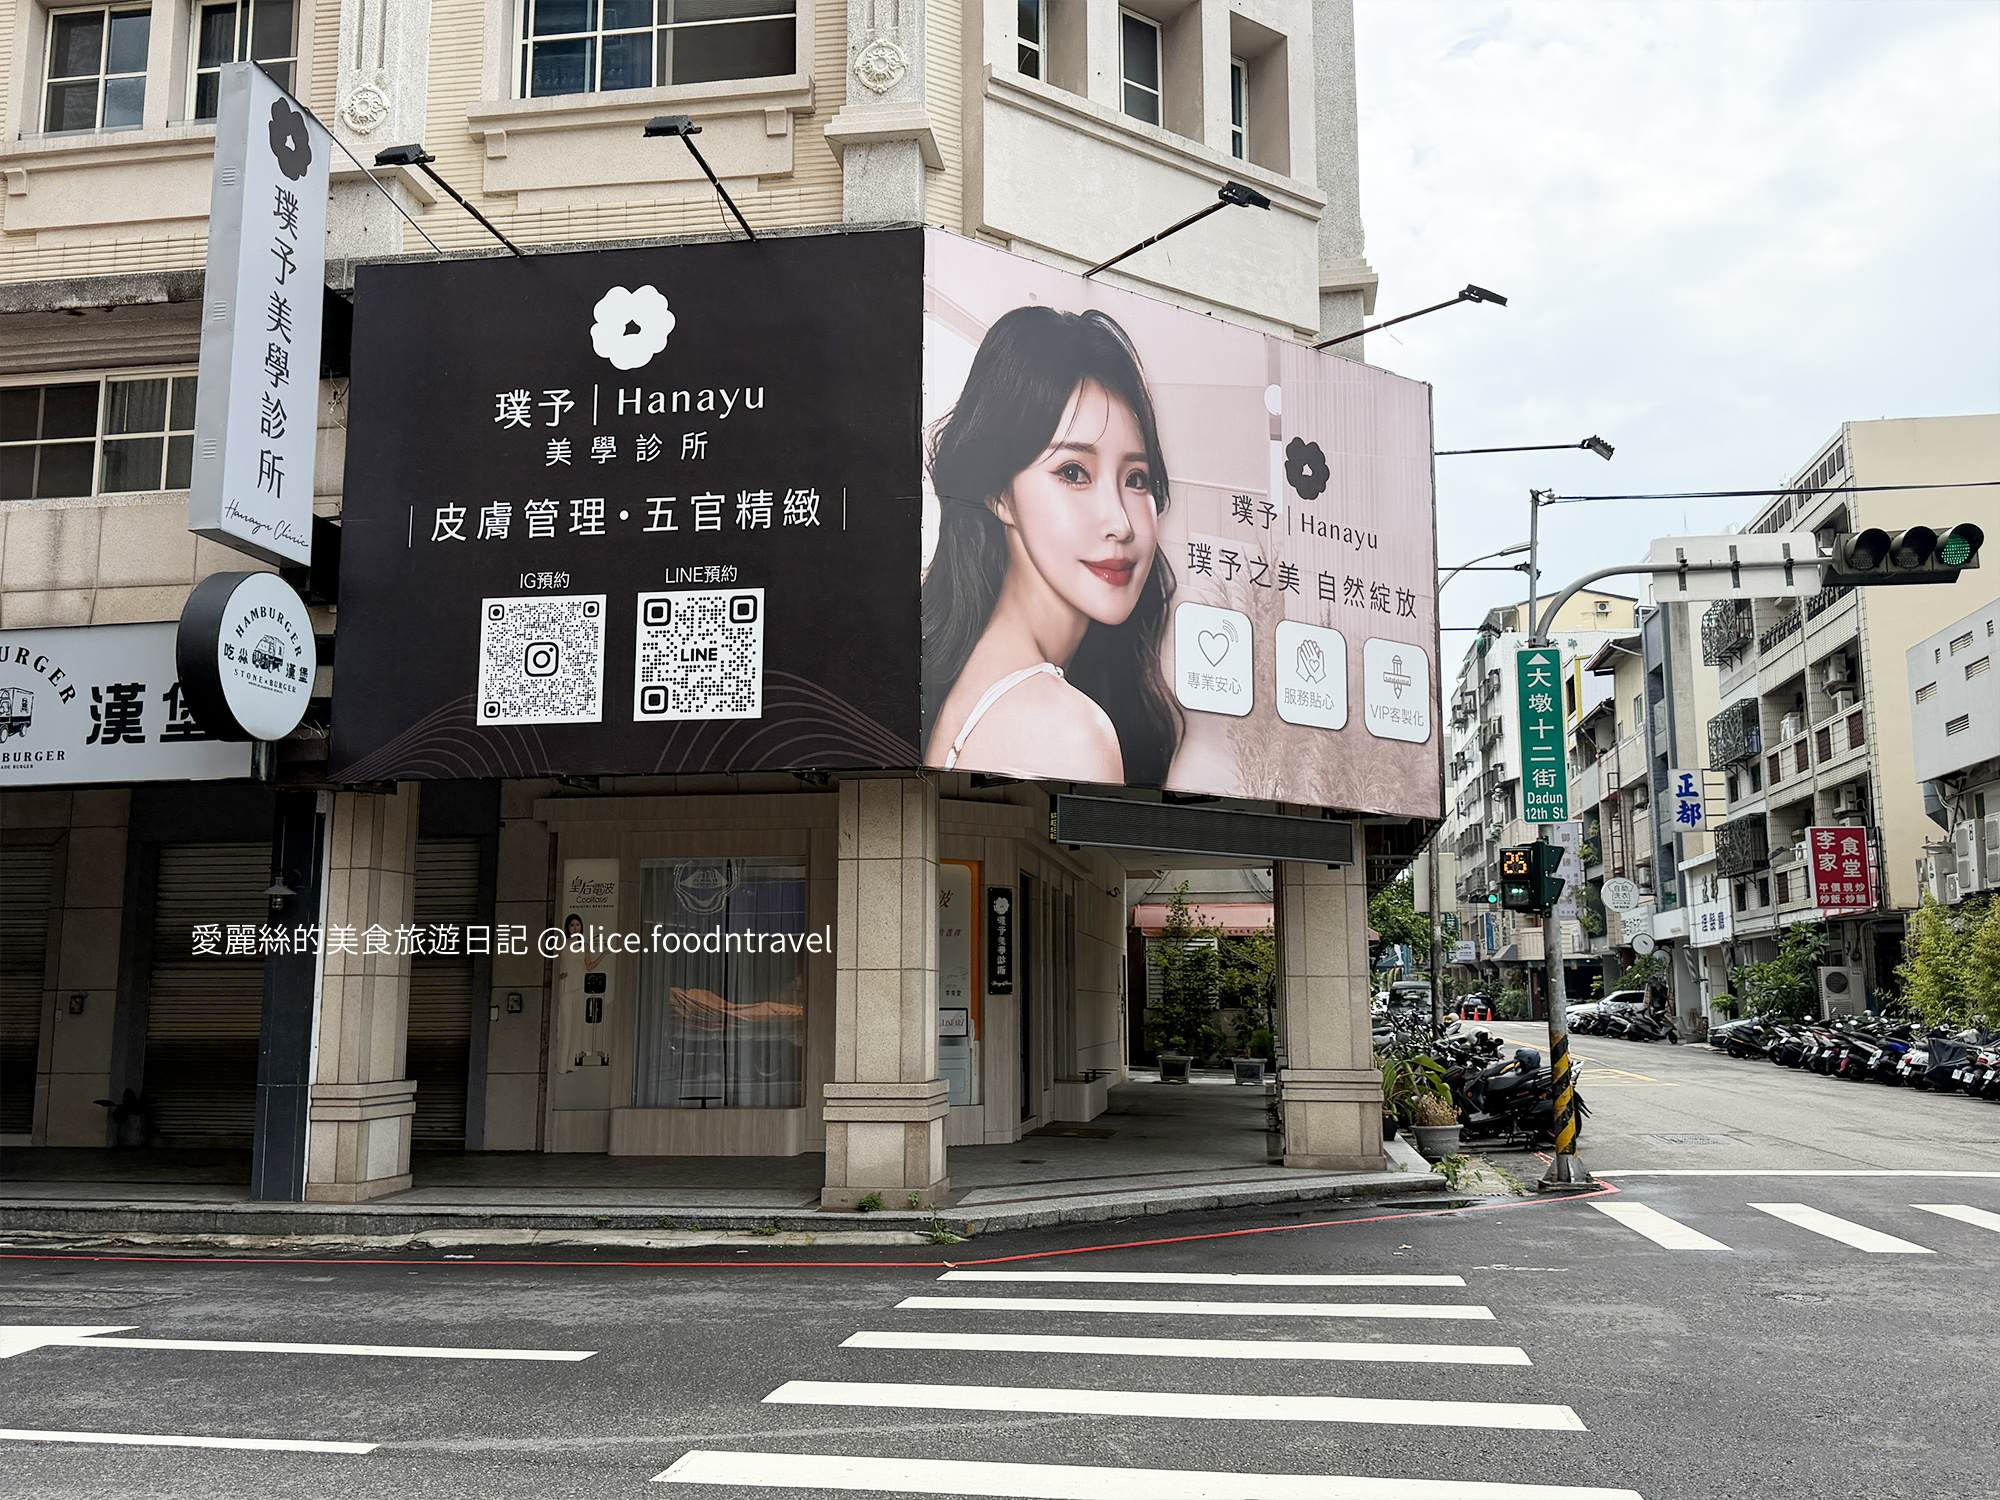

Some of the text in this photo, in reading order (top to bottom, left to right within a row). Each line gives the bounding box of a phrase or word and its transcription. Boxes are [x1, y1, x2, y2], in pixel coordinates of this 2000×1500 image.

[257, 185, 299, 498] 璞予美學診所
[494, 386, 766, 430] 璞予 Hanayu
[545, 431, 709, 468] 美學診所
[273, 519, 310, 548] Clinic
[1231, 494, 1379, 552] 璞予 Hanayu
[519, 571, 571, 590] IG預約
[665, 564, 738, 584] LINE預約
[1187, 542, 1418, 619] 璞予之美 自然綻放
[235, 606, 303, 657] HAMBURGER
[680, 647, 718, 662] LINE
[285, 662, 309, 684] 漢堡
[1187, 671, 1243, 695] 專業安心
[1283, 687, 1335, 711] 服務貼心
[1370, 703, 1425, 727] VIP客製化
[1526, 667, 1557, 789] 大墩十二街
[2, 750, 65, 763] BURGER
[1527, 792, 1564, 805] Dadun
[1675, 773, 1702, 828] 正都
[1525, 807, 1567, 820] 12th St.
[1503, 851, 1528, 875] 25
[1816, 830, 1838, 872] 李家
[1840, 836, 1862, 878] 食堂
[1819, 883, 1865, 892] 平價現炒
